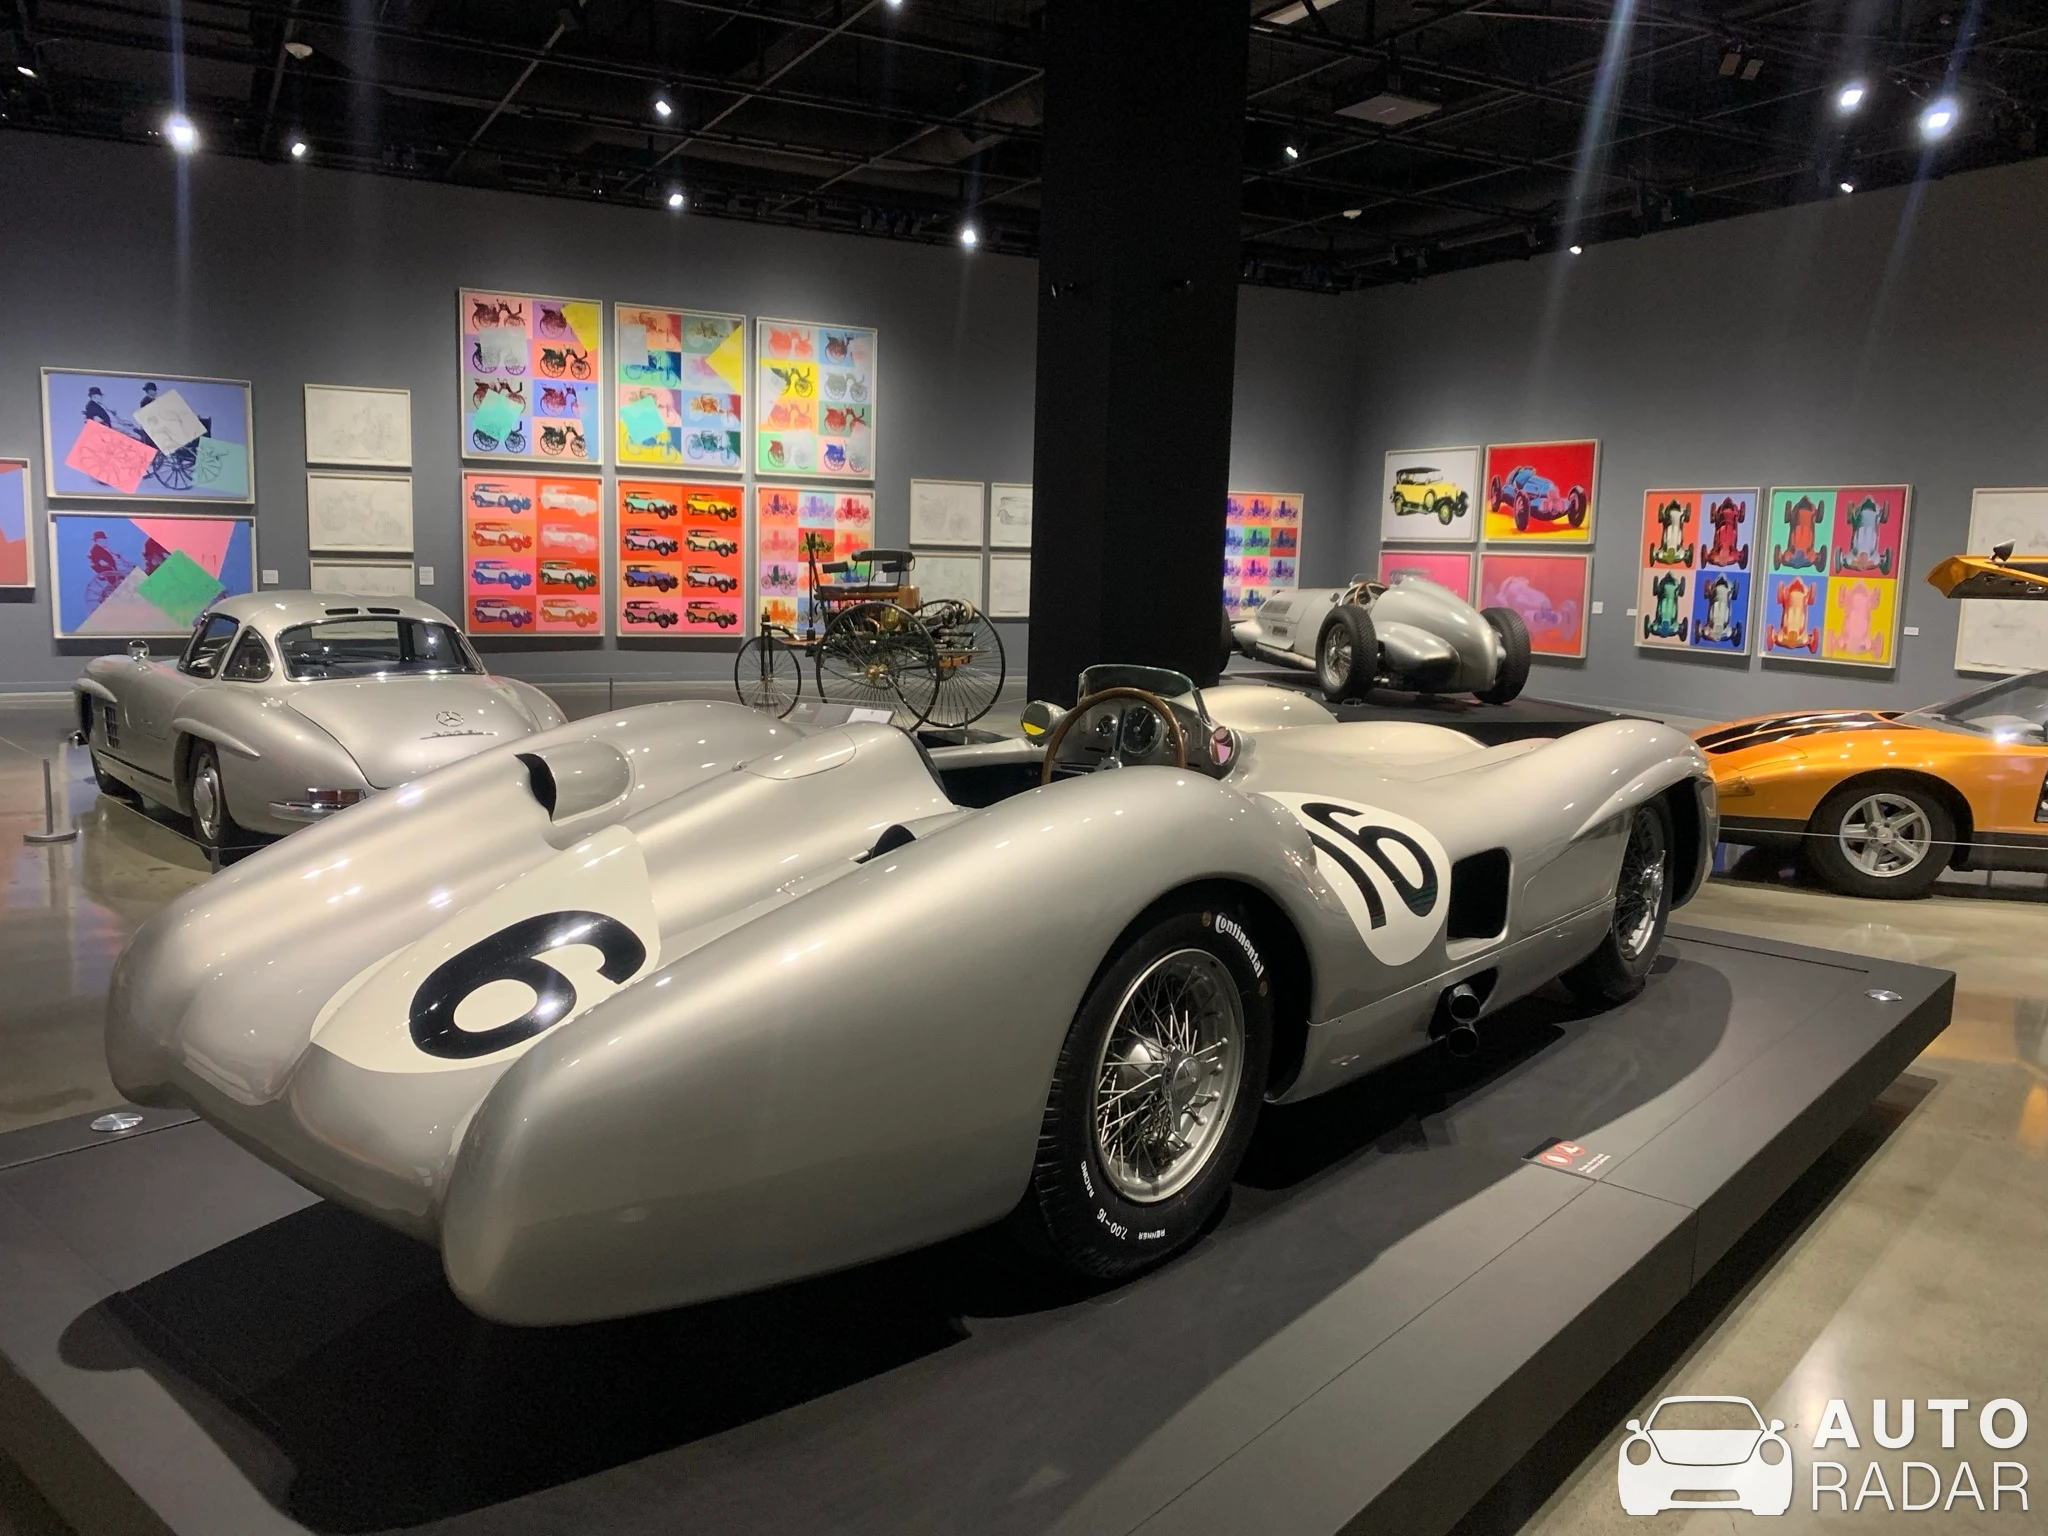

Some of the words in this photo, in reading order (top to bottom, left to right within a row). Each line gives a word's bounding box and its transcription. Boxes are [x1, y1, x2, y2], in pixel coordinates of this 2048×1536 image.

[1301, 802, 1438, 931] 16
[1215, 912, 1265, 979] Continental
[1080, 1160, 1095, 1198] RACING
[1138, 1228, 1166, 1241] RENNER
